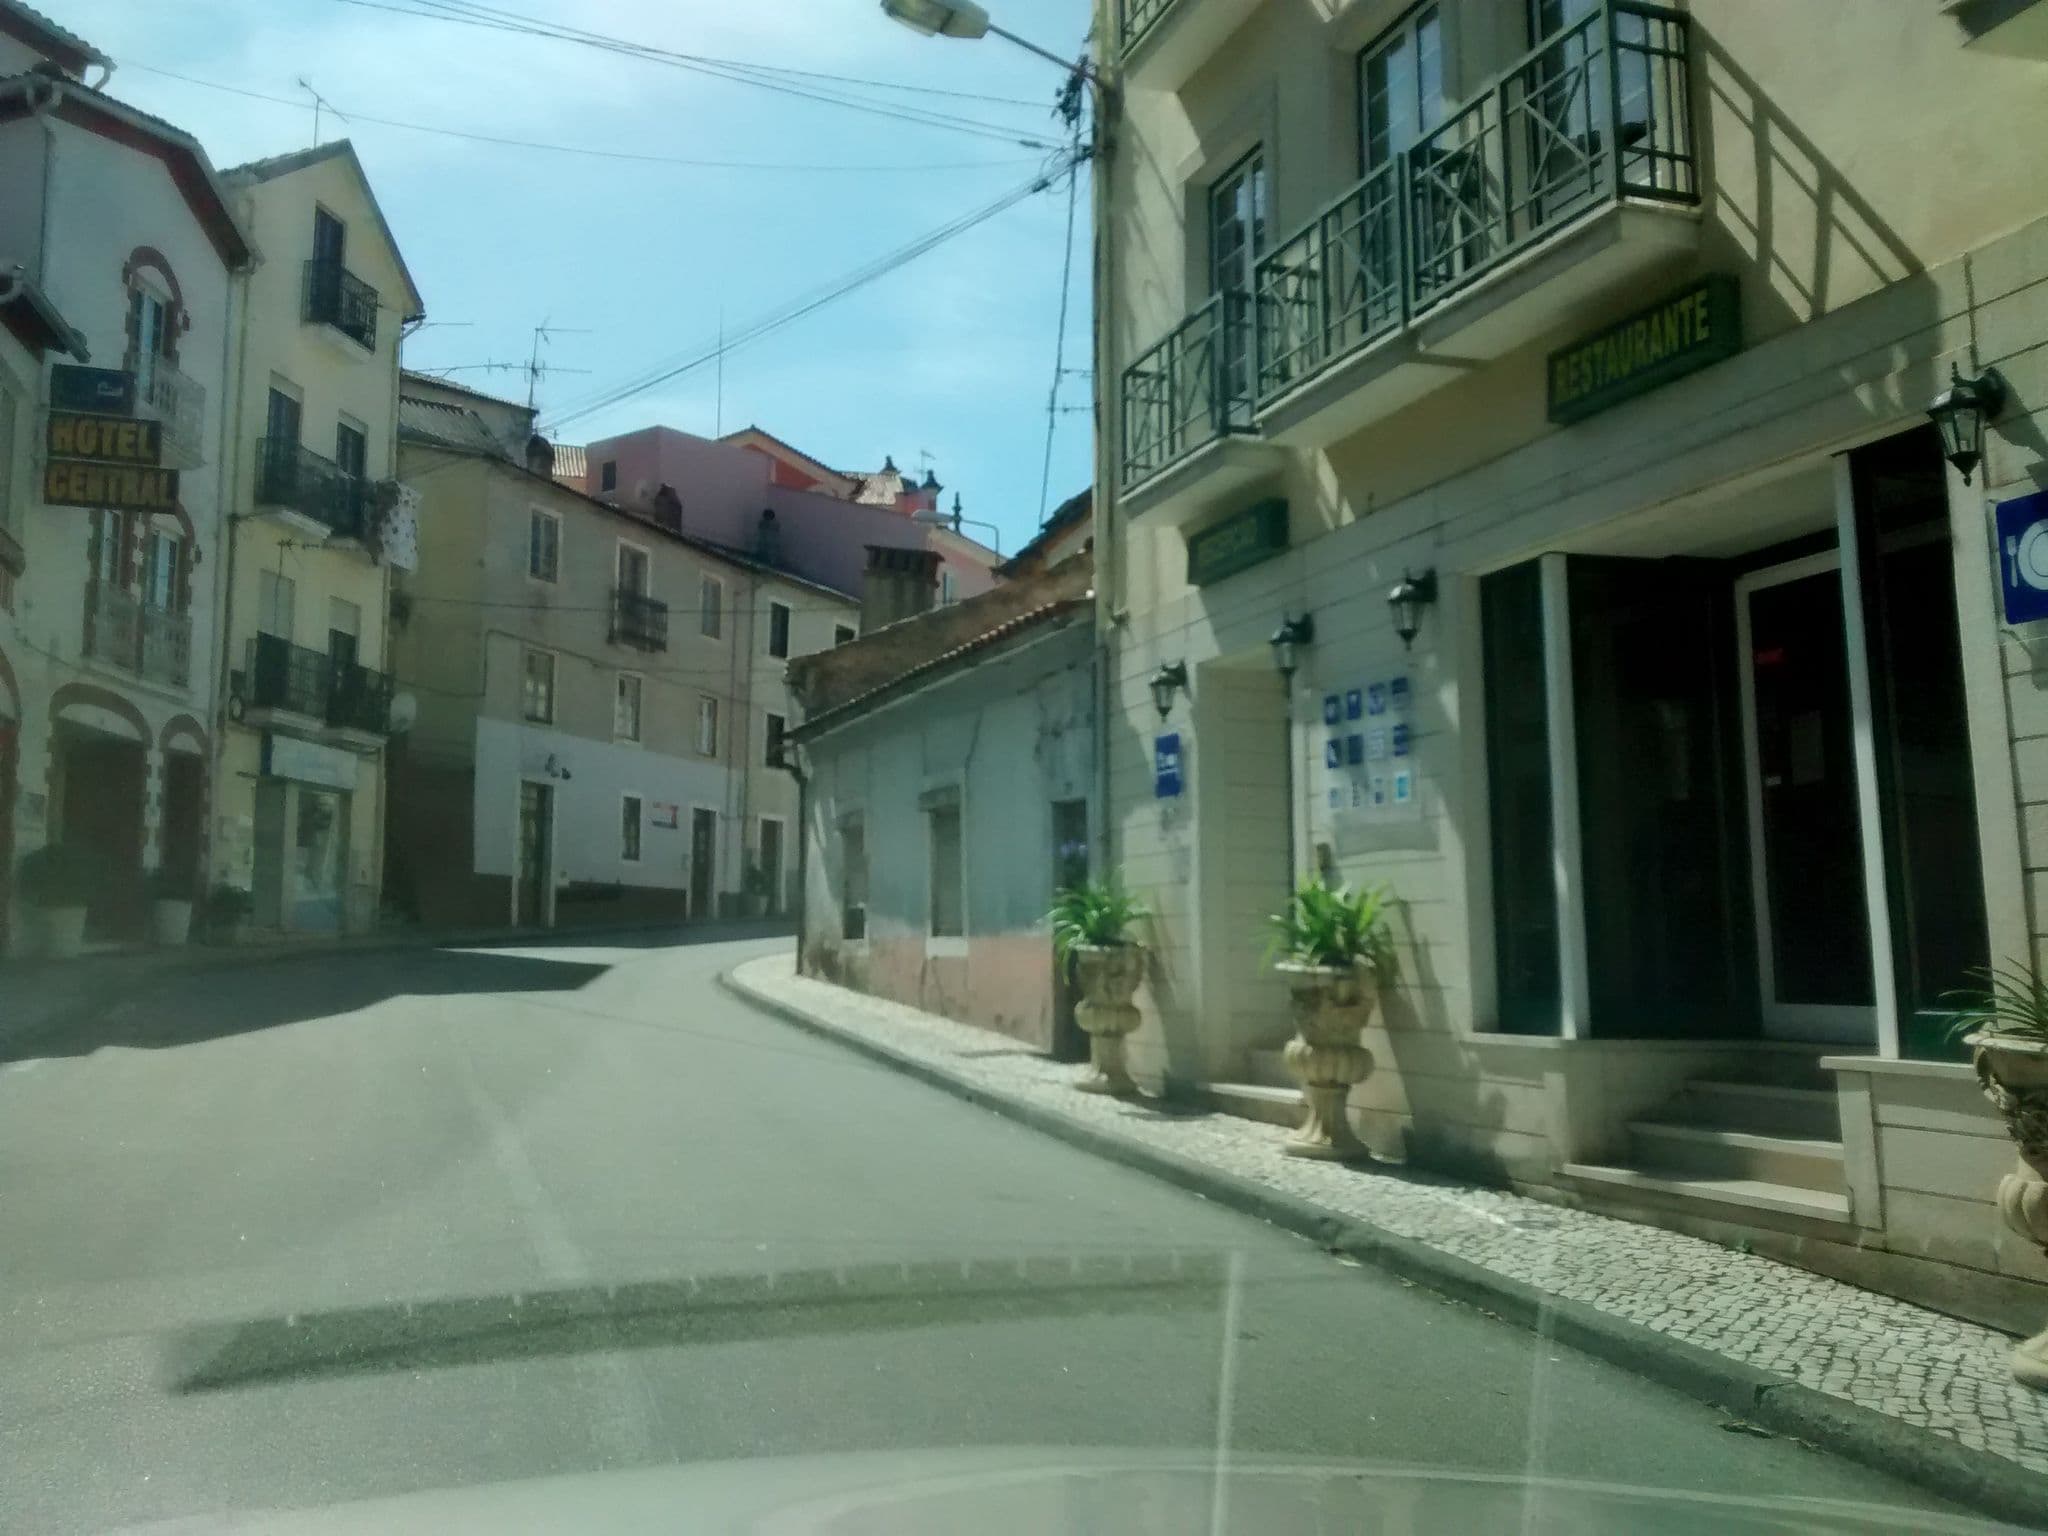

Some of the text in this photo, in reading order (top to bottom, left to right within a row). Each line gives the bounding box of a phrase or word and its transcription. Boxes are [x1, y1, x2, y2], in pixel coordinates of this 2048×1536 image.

[1554, 288, 1711, 406] RESTAURANTE
[51, 417, 153, 458] HOTEL
[48, 463, 169, 507] CENTRAL
